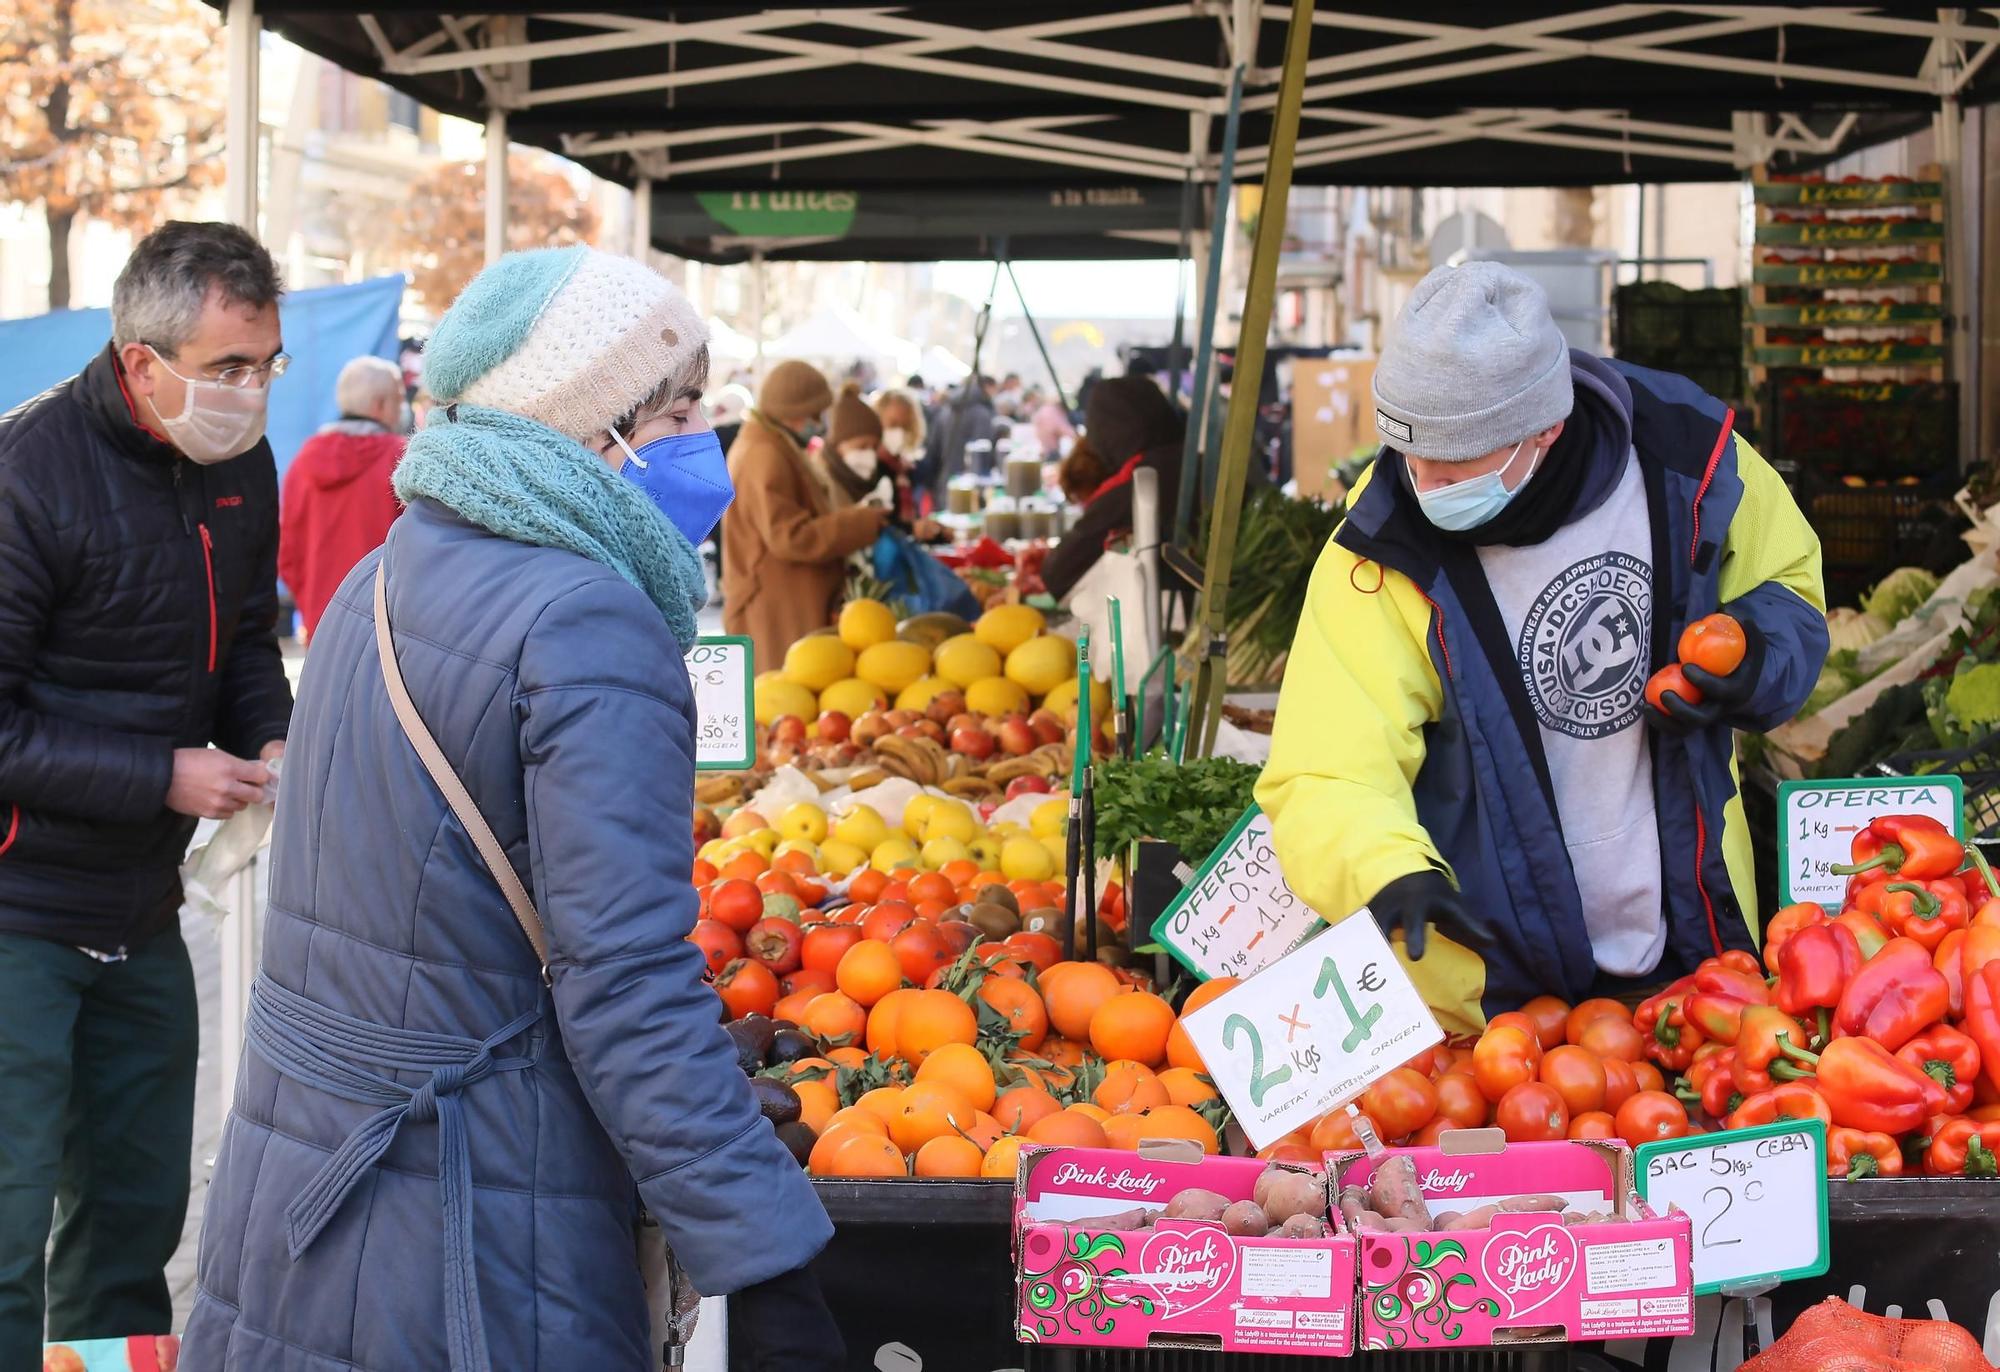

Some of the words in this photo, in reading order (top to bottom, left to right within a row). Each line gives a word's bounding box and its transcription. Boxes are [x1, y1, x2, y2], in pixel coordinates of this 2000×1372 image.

[1521, 603, 1546, 670] FOOTWEAR
[1543, 580, 1563, 604] AND
[685, 646, 728, 664] OS
[723, 713, 738, 727] Kg
[1613, 708, 1639, 729] 1994
[1796, 788, 1937, 809] OFERTA
[1799, 817, 1810, 841] 1
[1814, 820, 1828, 838] Kg
[1174, 828, 1267, 935] OFERTA
[1800, 857, 1811, 880] 2
[1814, 860, 1829, 877] Kgs
[1793, 884, 1841, 893] VARIETAT
[1191, 936, 1208, 956] 1
[1202, 925, 1220, 942] Kg
[1221, 962, 1239, 978] 2
[1230, 950, 1247, 968] Kgs
[1222, 1013, 1293, 1107] 2
[1313, 956, 1383, 1053] 1
[1357, 962, 1386, 991] €
[1371, 1021, 1422, 1057] ORIGEN
[1290, 1044, 1321, 1074] Kgs
[1328, 1077, 1354, 1097] terra
[1259, 1088, 1310, 1124] VARIETAT
[1649, 1152, 1698, 1178] SAC
[1755, 1132, 1809, 1159] CEBA
[1053, 1162, 1107, 1185] Pink
[1155, 1235, 1219, 1275] Pink
[1497, 1232, 1559, 1277] Pink
